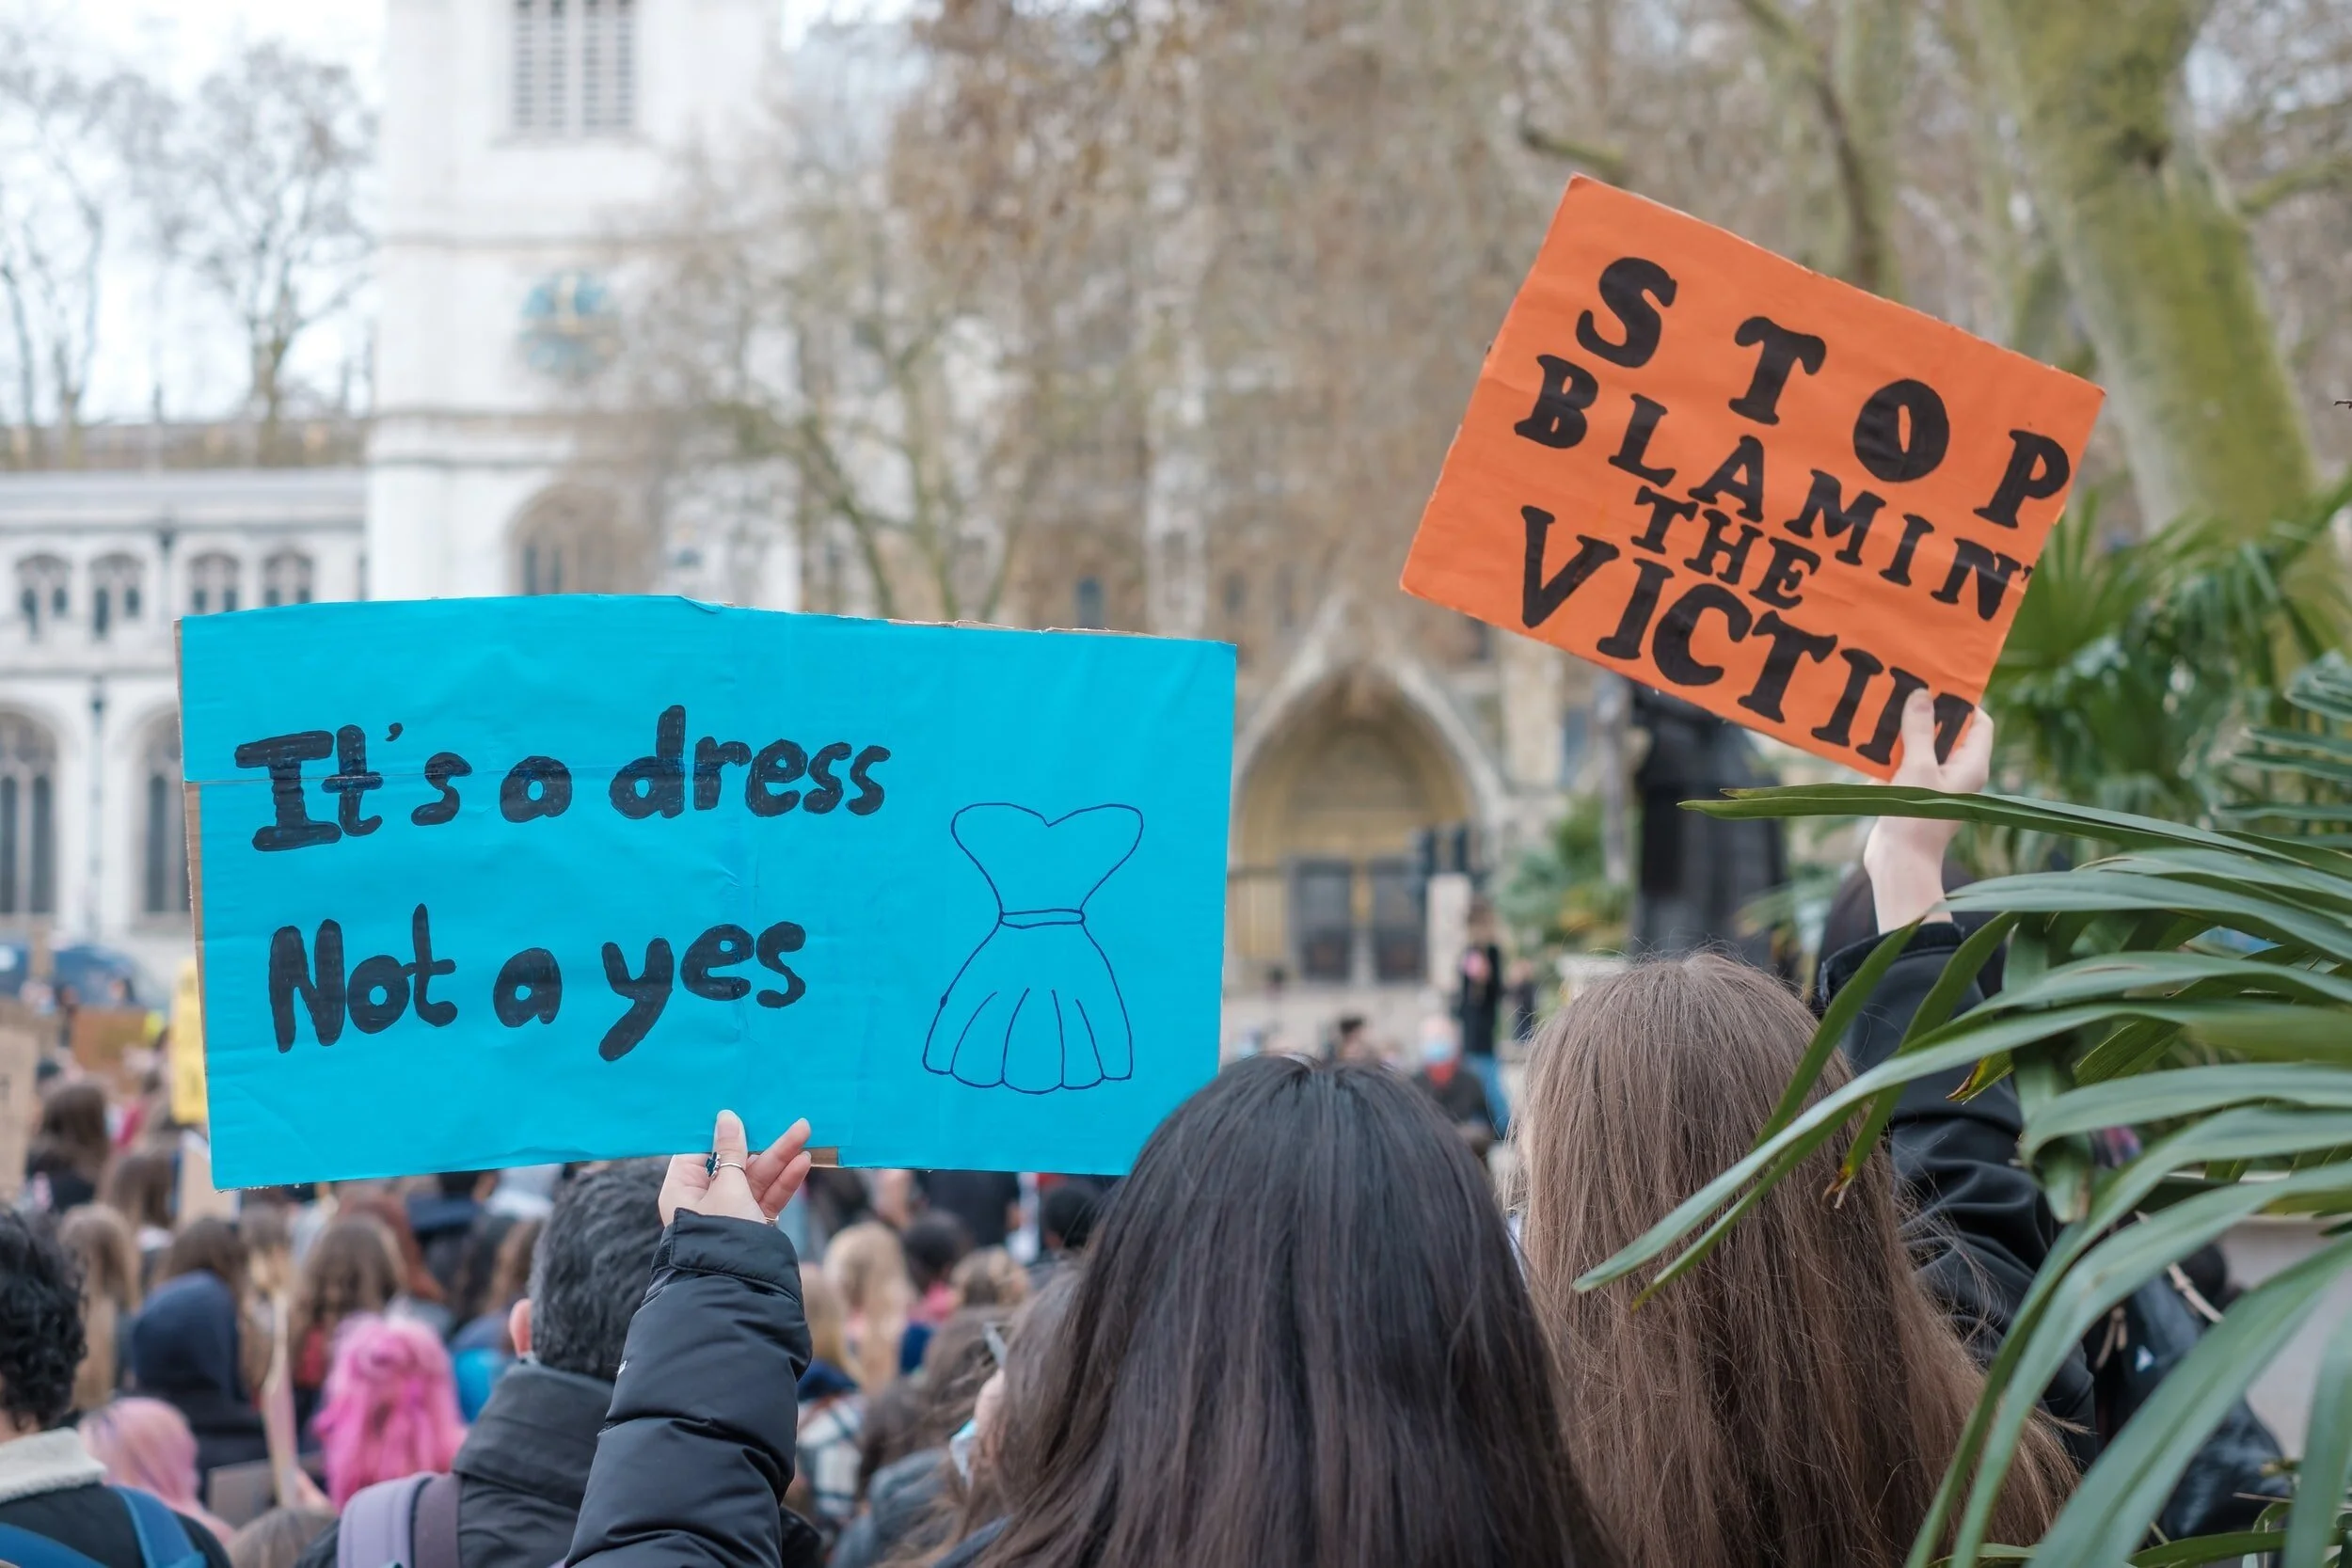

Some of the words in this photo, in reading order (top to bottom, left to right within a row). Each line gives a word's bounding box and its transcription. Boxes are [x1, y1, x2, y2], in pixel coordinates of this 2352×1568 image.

[1575, 256, 2071, 530] STOP
[1514, 354, 2034, 622] BLAMIN'
[1629, 485, 1821, 610] THE
[233, 722, 473, 852] It's
[500, 755, 573, 823] a
[610, 705, 893, 818] dress
[268, 903, 459, 1053] Not
[493, 947, 563, 1027] a
[597, 921, 807, 1063] yes
